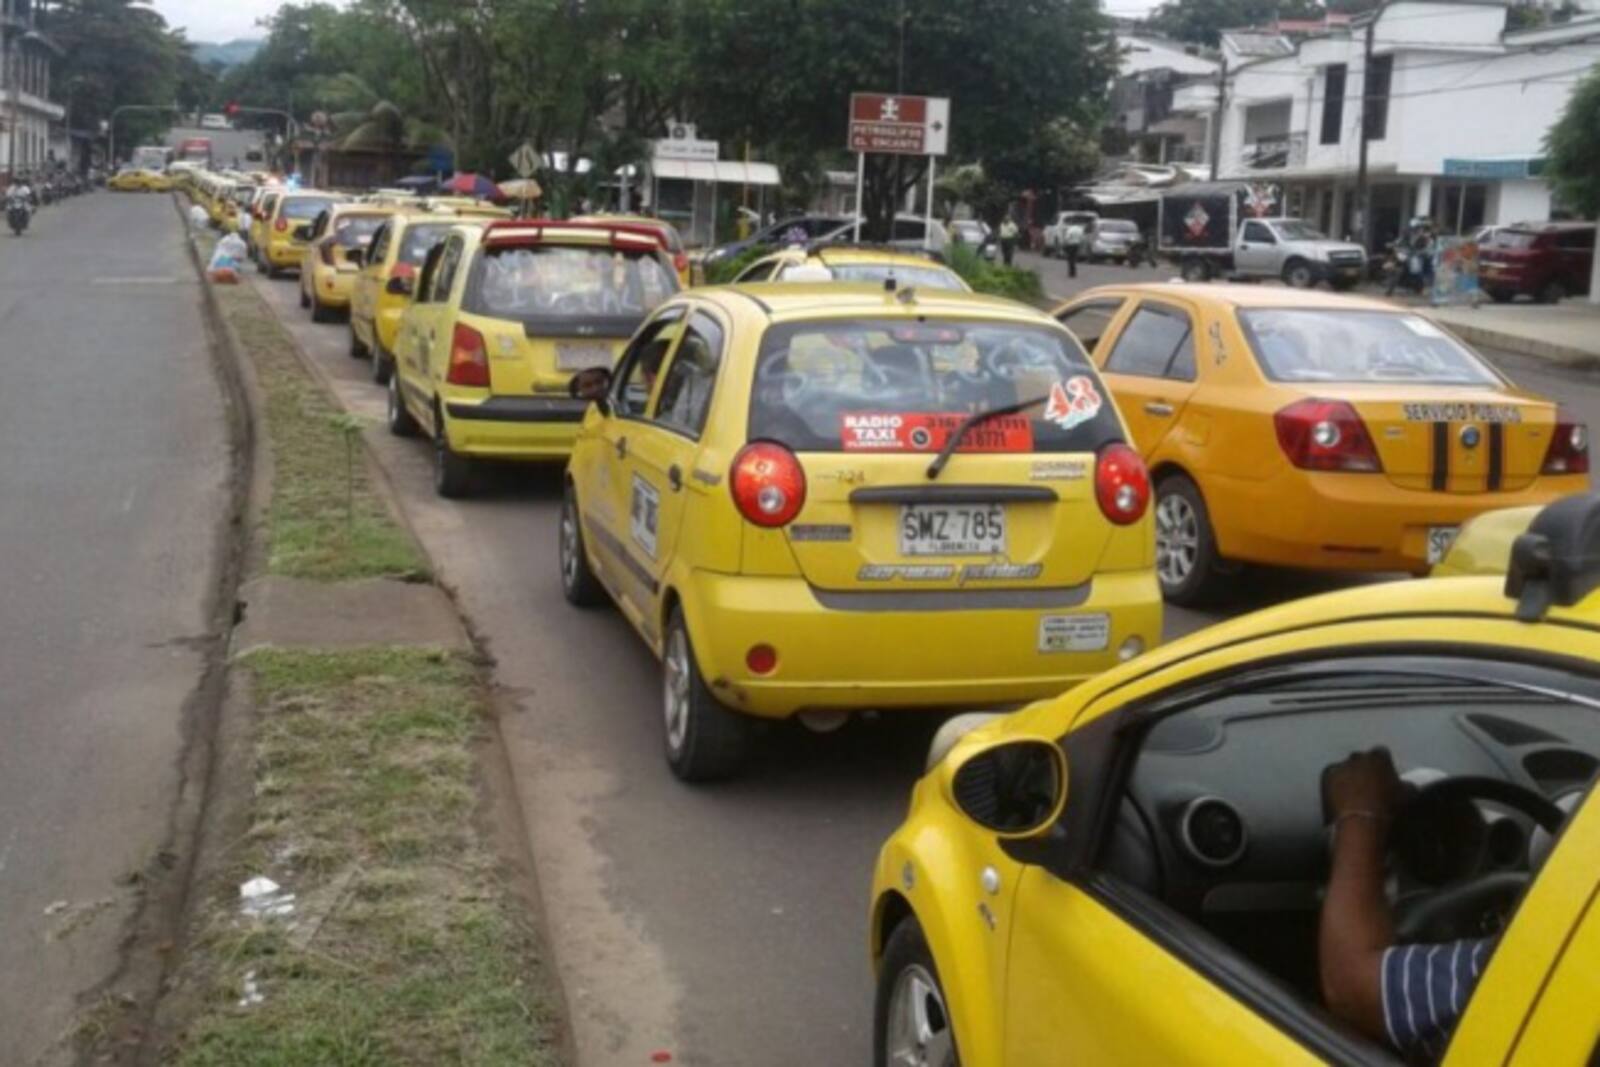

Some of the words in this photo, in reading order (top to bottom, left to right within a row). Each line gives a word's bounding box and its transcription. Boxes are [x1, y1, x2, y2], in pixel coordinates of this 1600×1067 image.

[845, 414, 903, 429] RADIO
[853, 428, 897, 441] TAXI
[904, 510, 950, 541] SMZ
[957, 510, 1002, 541] 785
